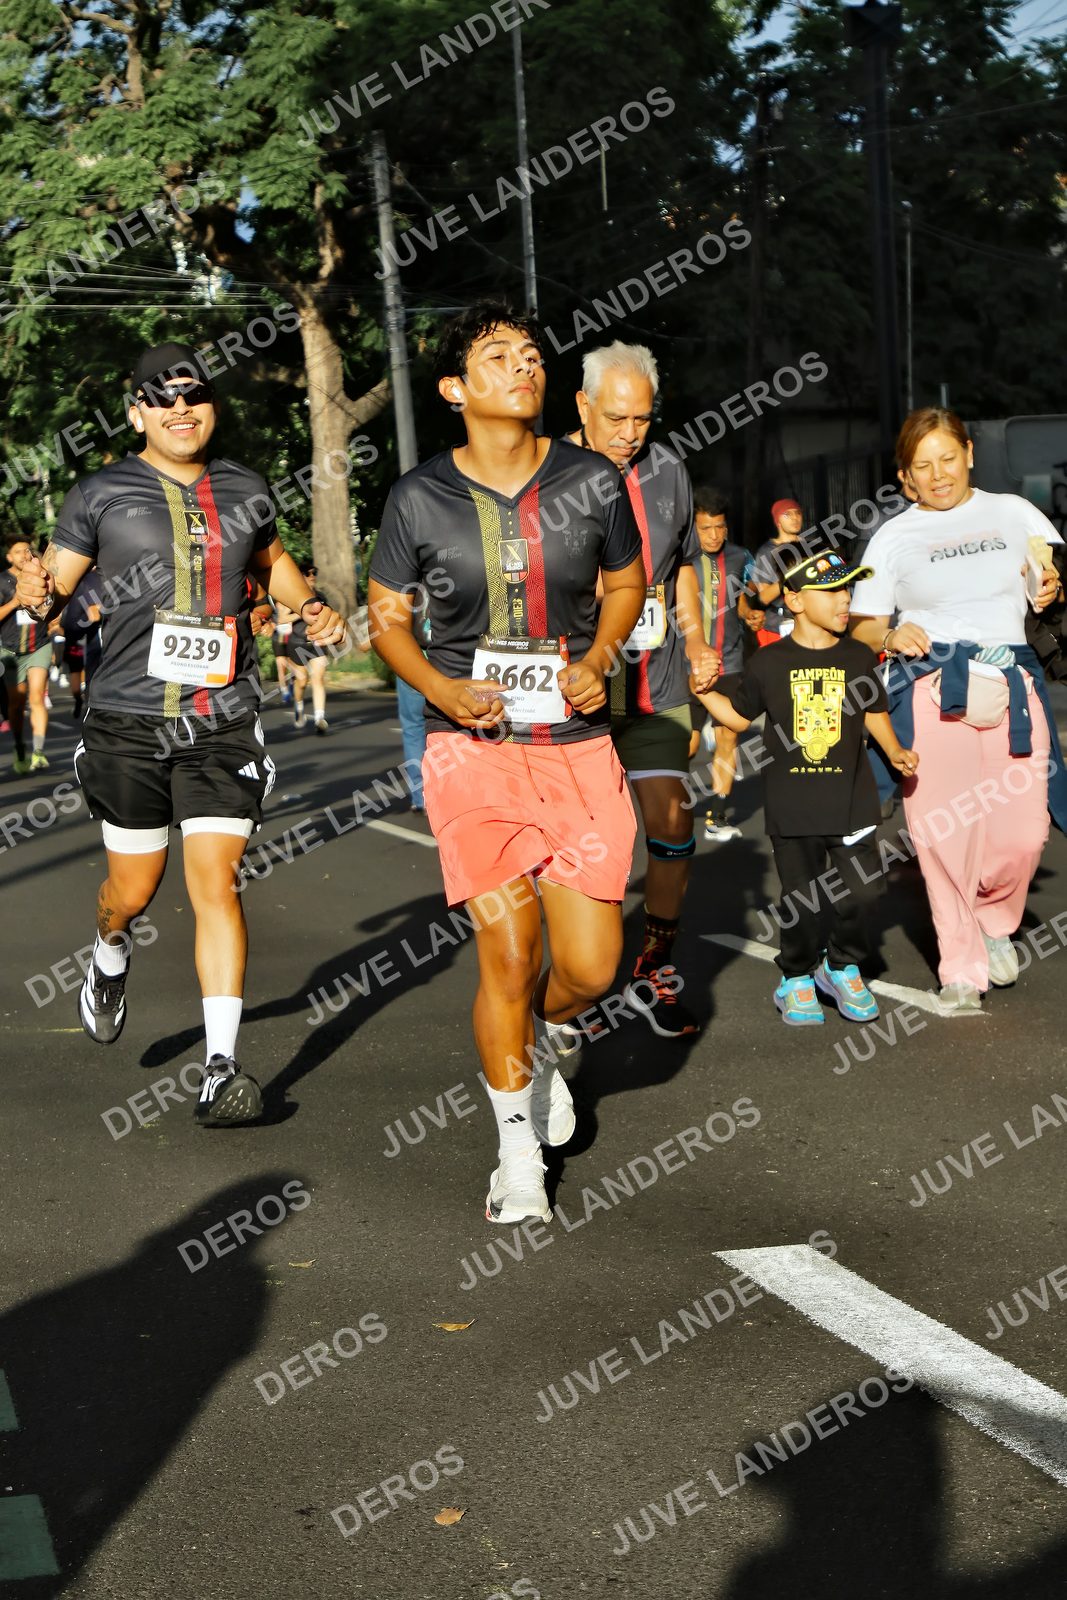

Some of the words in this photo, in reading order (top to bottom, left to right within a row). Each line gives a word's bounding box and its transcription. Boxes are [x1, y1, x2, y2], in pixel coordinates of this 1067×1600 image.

[163, 634, 221, 662] 9239
[483, 663, 553, 692] 8662
[790, 667, 845, 681] CAMPEÓN
